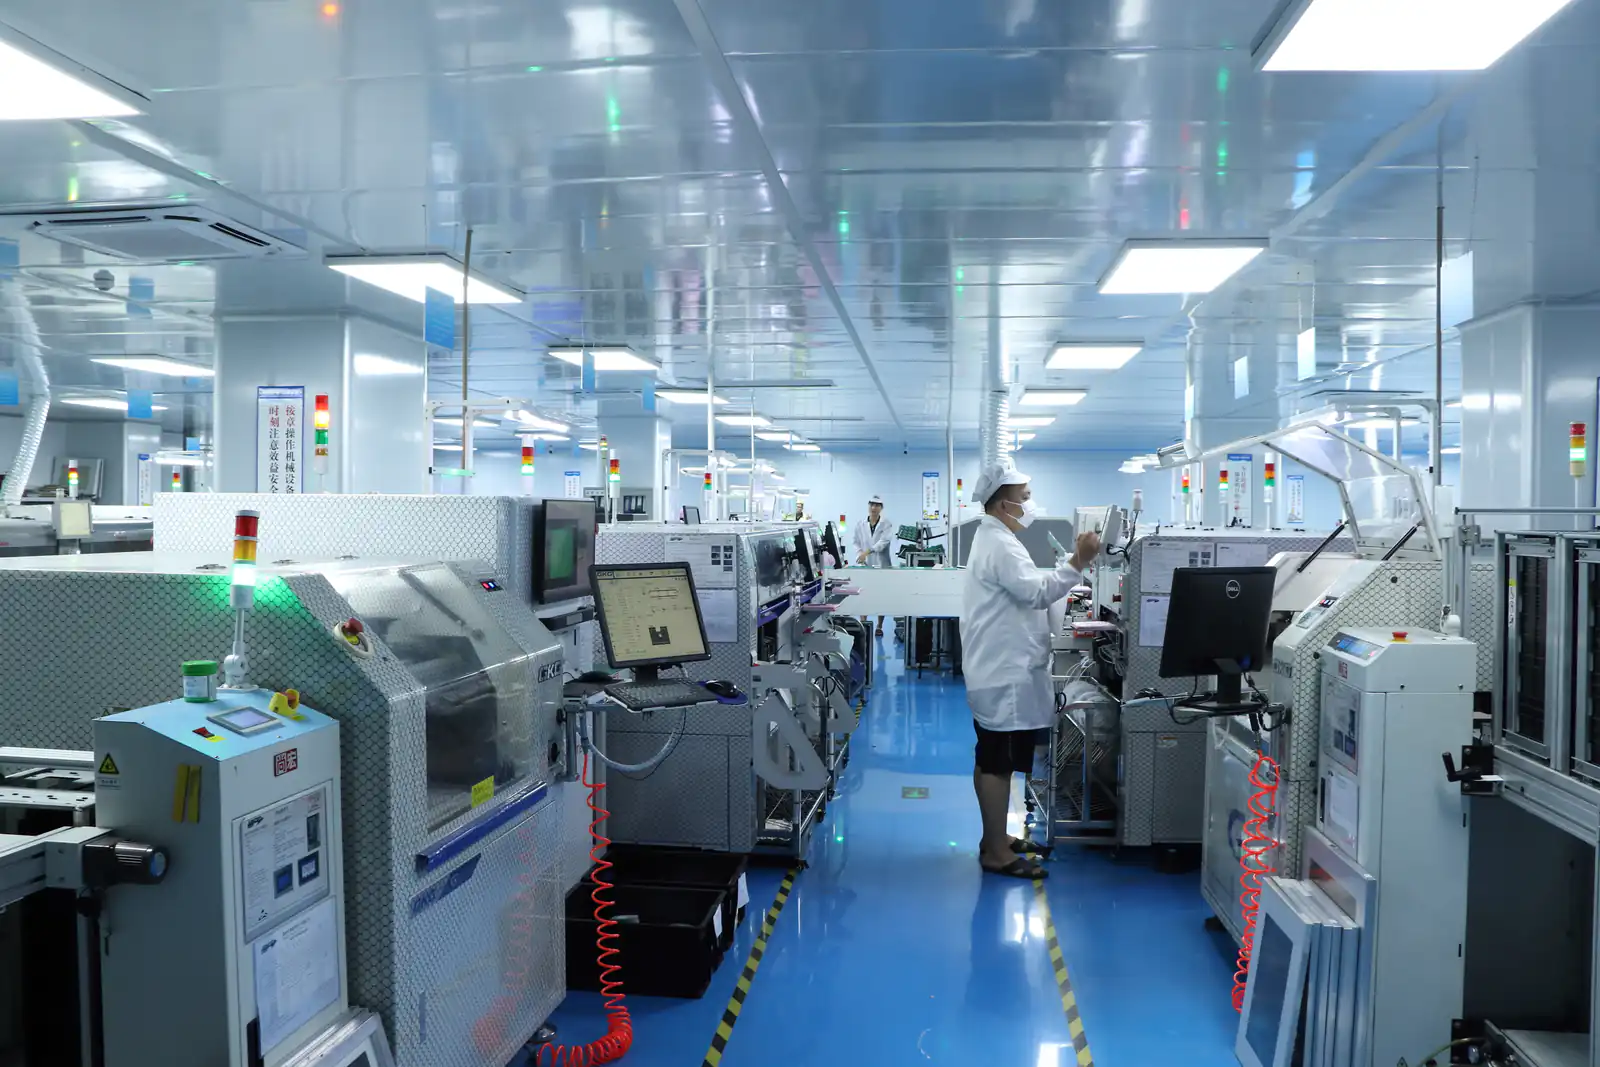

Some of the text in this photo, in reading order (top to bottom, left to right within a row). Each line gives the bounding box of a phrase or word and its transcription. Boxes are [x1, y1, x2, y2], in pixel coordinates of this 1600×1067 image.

[268, 405, 280, 493] 时刻注意效益安全
[285, 405, 296, 493] 按章操作机械设备
